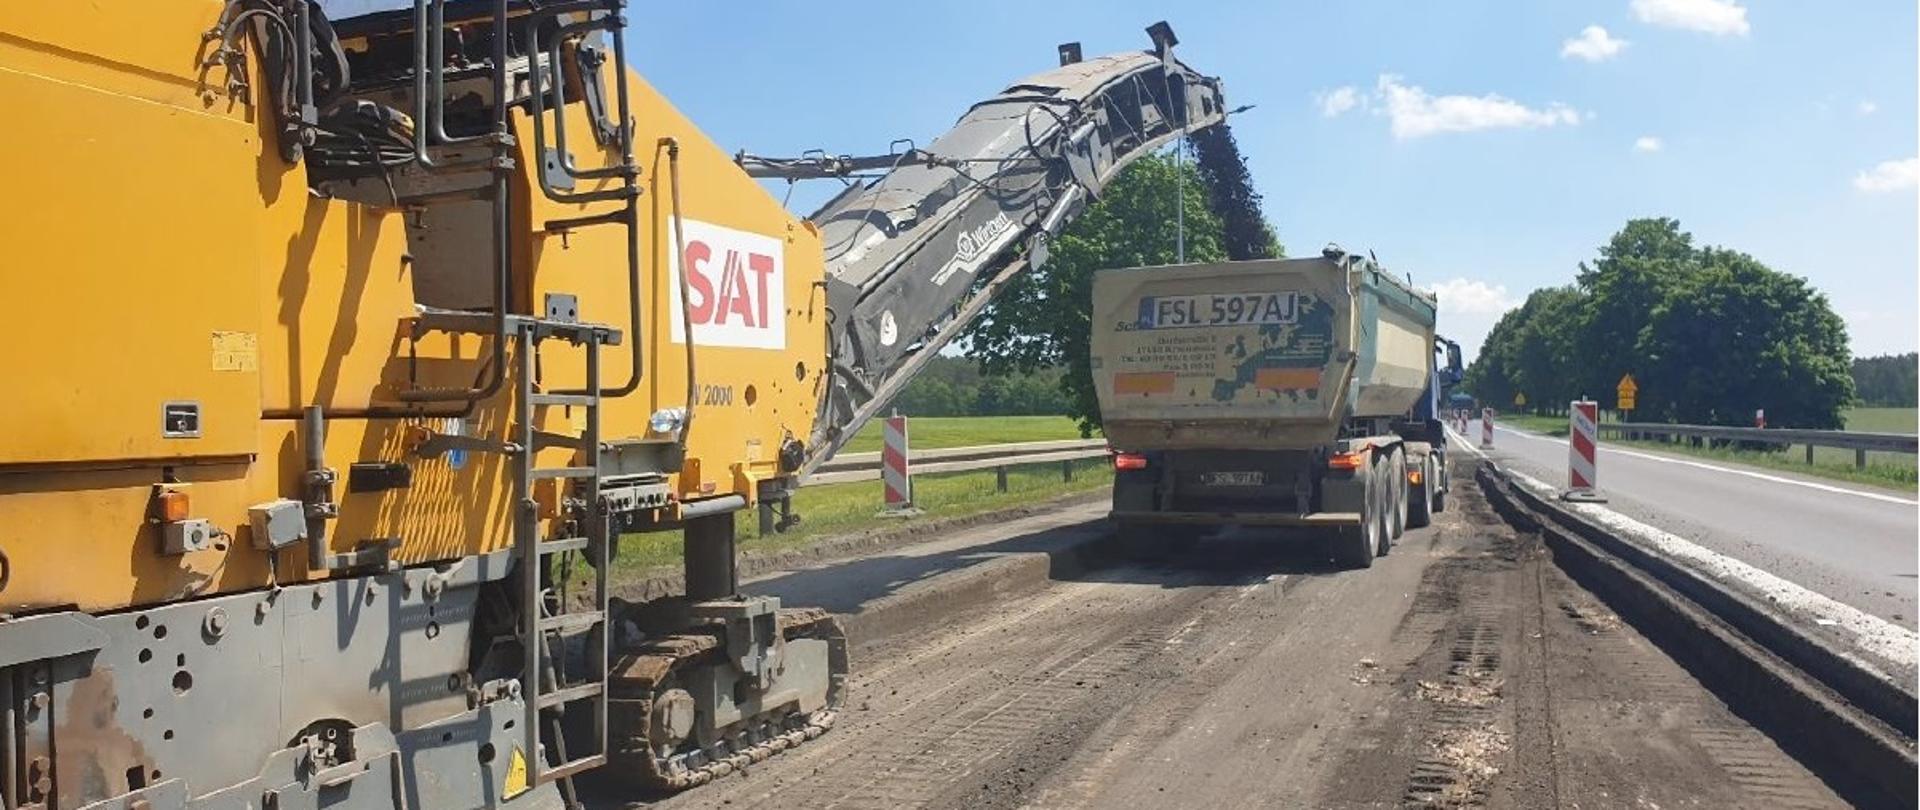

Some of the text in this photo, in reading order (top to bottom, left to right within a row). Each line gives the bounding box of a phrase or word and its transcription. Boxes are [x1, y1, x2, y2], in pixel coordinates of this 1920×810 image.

[685, 240, 774, 329] SAT
[1158, 294, 1295, 325] FSL 597AJ
[704, 384, 733, 406] 2000
